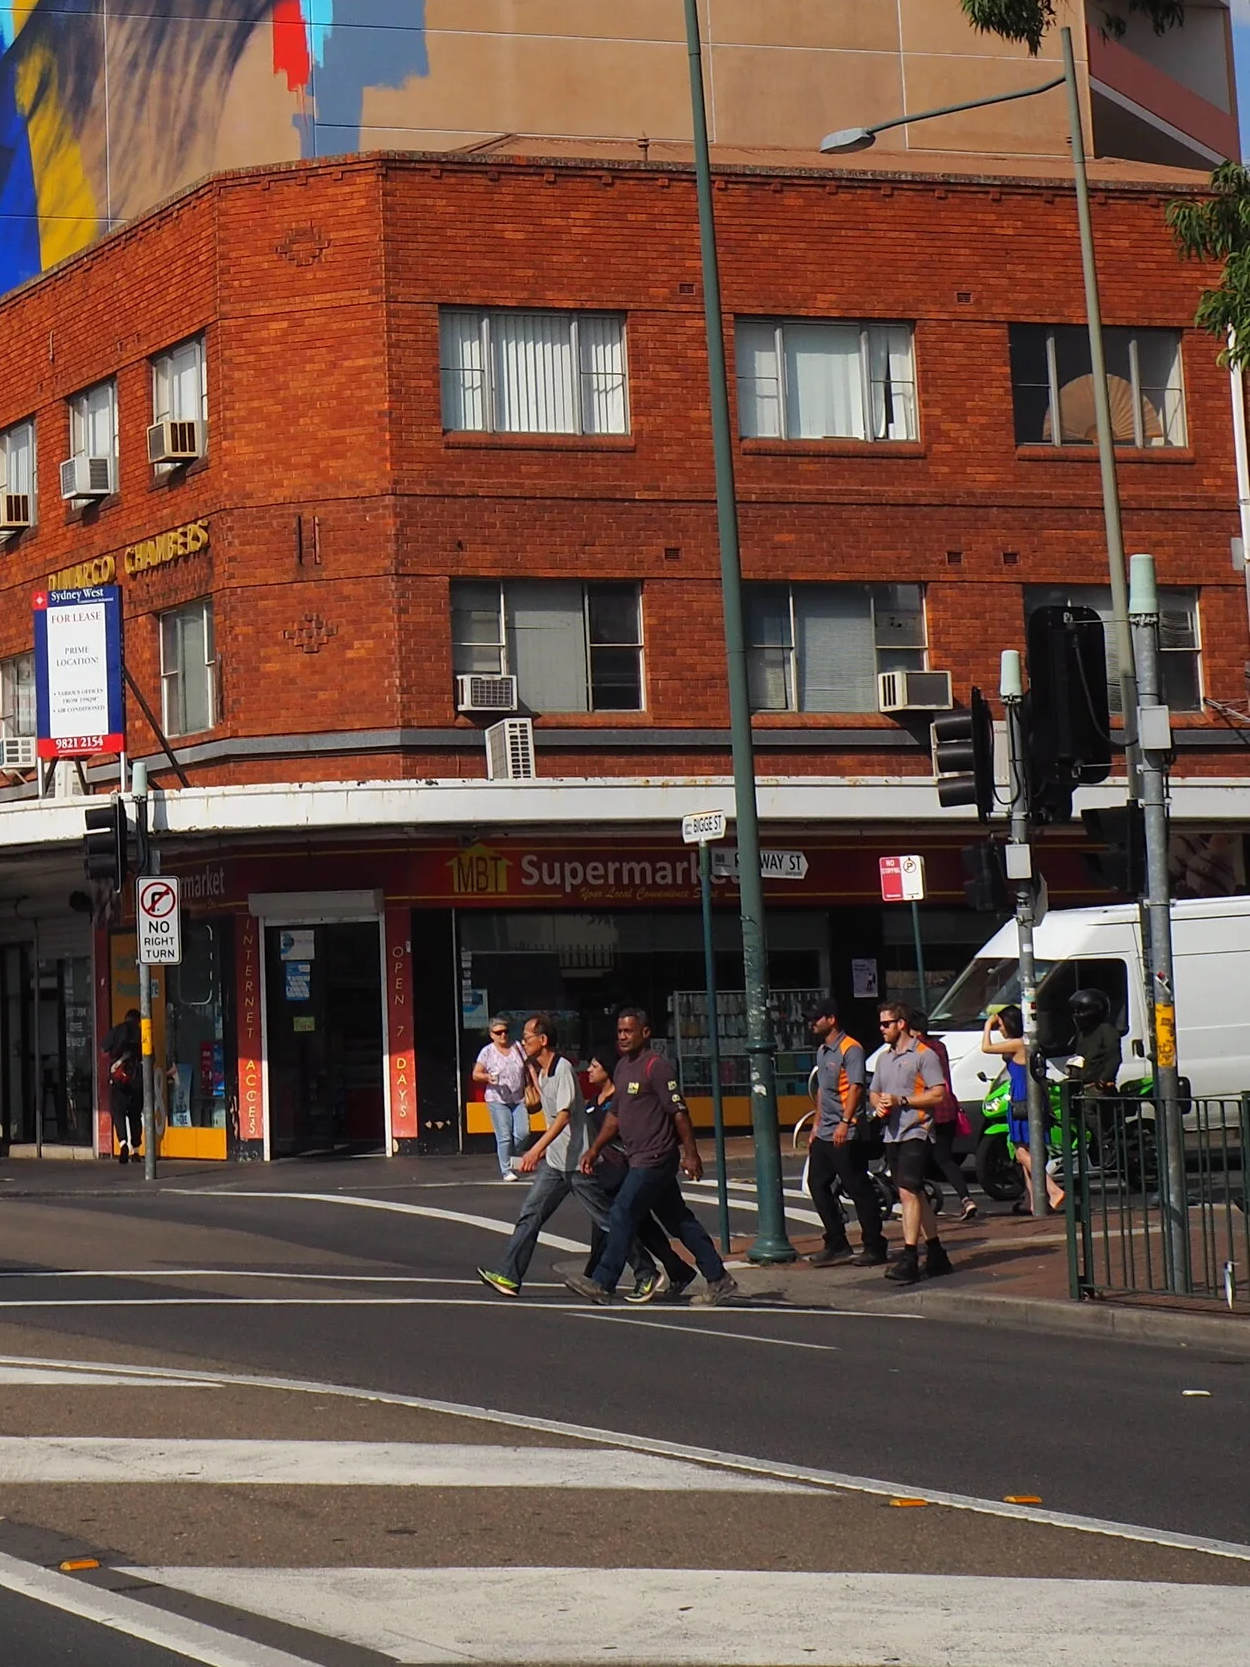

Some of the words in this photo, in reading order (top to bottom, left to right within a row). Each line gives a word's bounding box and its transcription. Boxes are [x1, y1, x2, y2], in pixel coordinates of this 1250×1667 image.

[124, 519, 210, 575] CHAMBERS
[51, 590, 82, 603] Sydney
[82, 588, 104, 598] West
[51, 614, 71, 624] FOR
[73, 612, 102, 622] LEASE
[65, 646, 89, 655] PRIME
[56, 737, 78, 750] 9821
[81, 735, 104, 747] 2154
[693, 816, 713, 833] BIGGE
[714, 815, 722, 830] ST
[789, 855, 802, 871] ST
[456, 855, 503, 893] MBT
[148, 920, 170, 934] NO
[144, 936, 175, 946] RIGHT
[146, 949, 175, 959] TURN
[243, 917, 255, 1039] INTERNET
[392, 945, 405, 1006] OPEN
[397, 1025, 405, 1037] 7
[396, 1056, 408, 1118] DAYS
